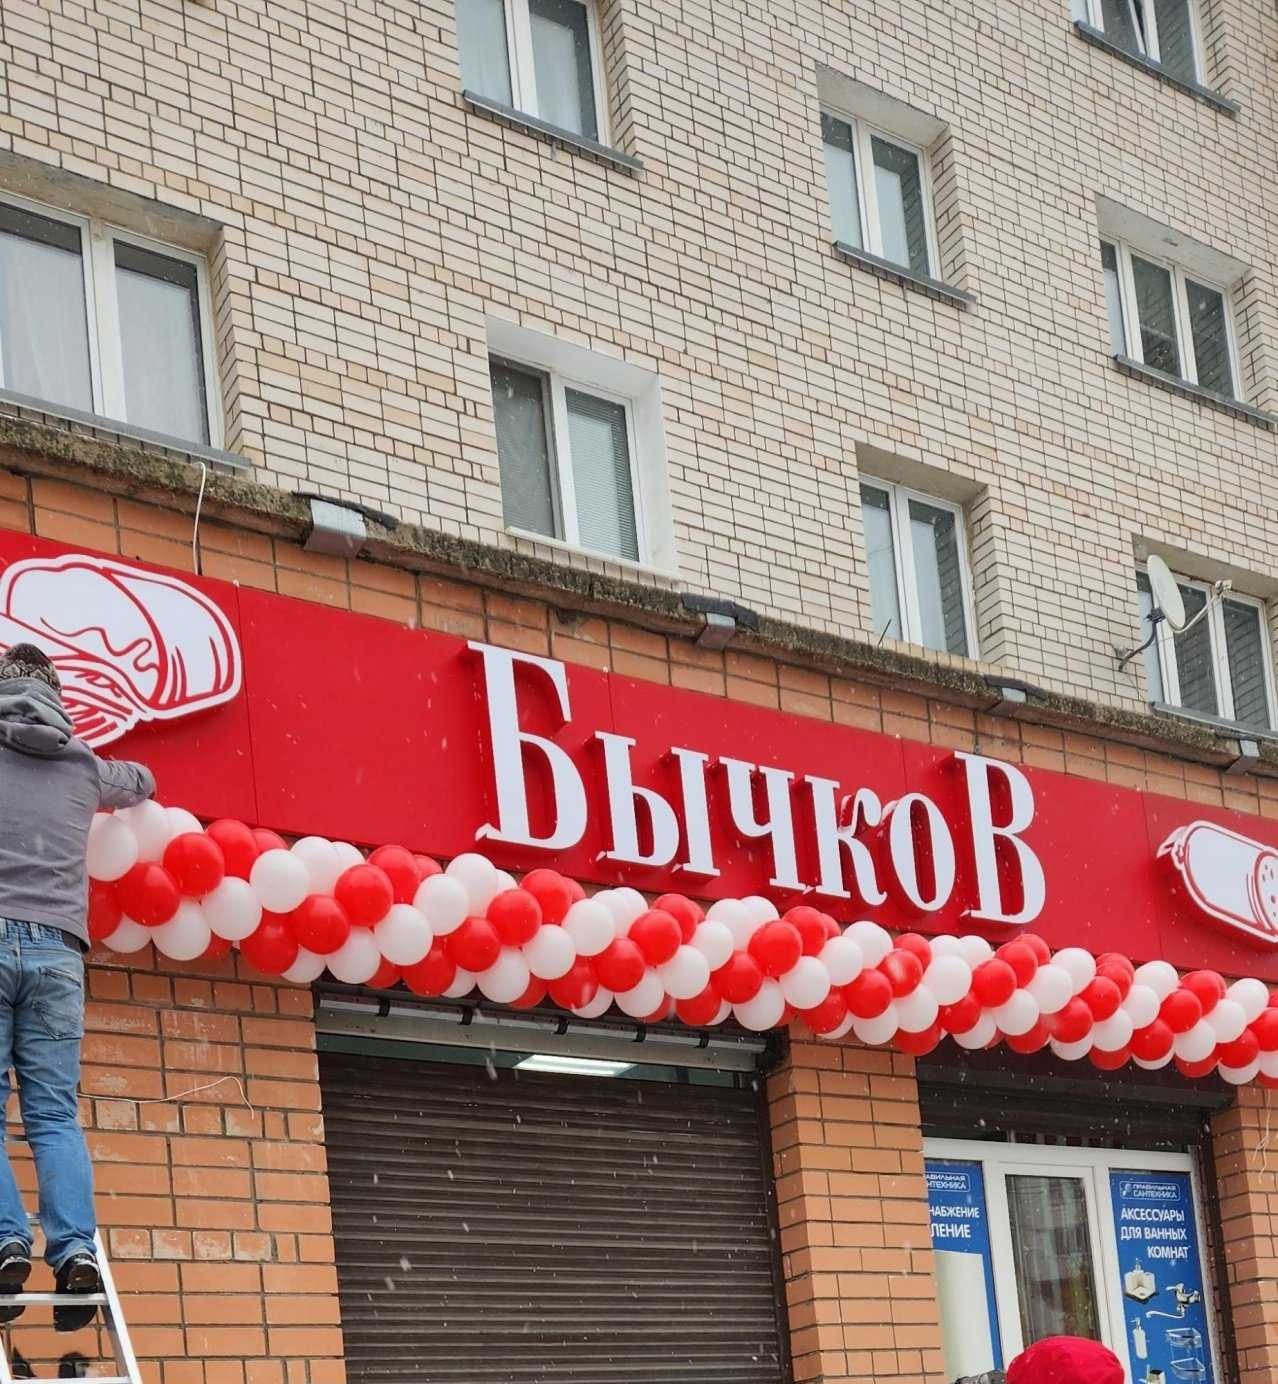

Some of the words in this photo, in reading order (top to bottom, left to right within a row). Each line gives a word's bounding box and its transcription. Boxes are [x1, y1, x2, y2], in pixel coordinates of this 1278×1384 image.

[1121, 1207, 1185, 1222] АКСЕССУАРЫ
[930, 1222, 972, 1239] ЛЕНИЕ
[1120, 1226, 1142, 1240] ДЛЯ
[1144, 1227, 1187, 1240] ВАННЫХ
[1147, 1245, 1189, 1259] КОМНАТ
